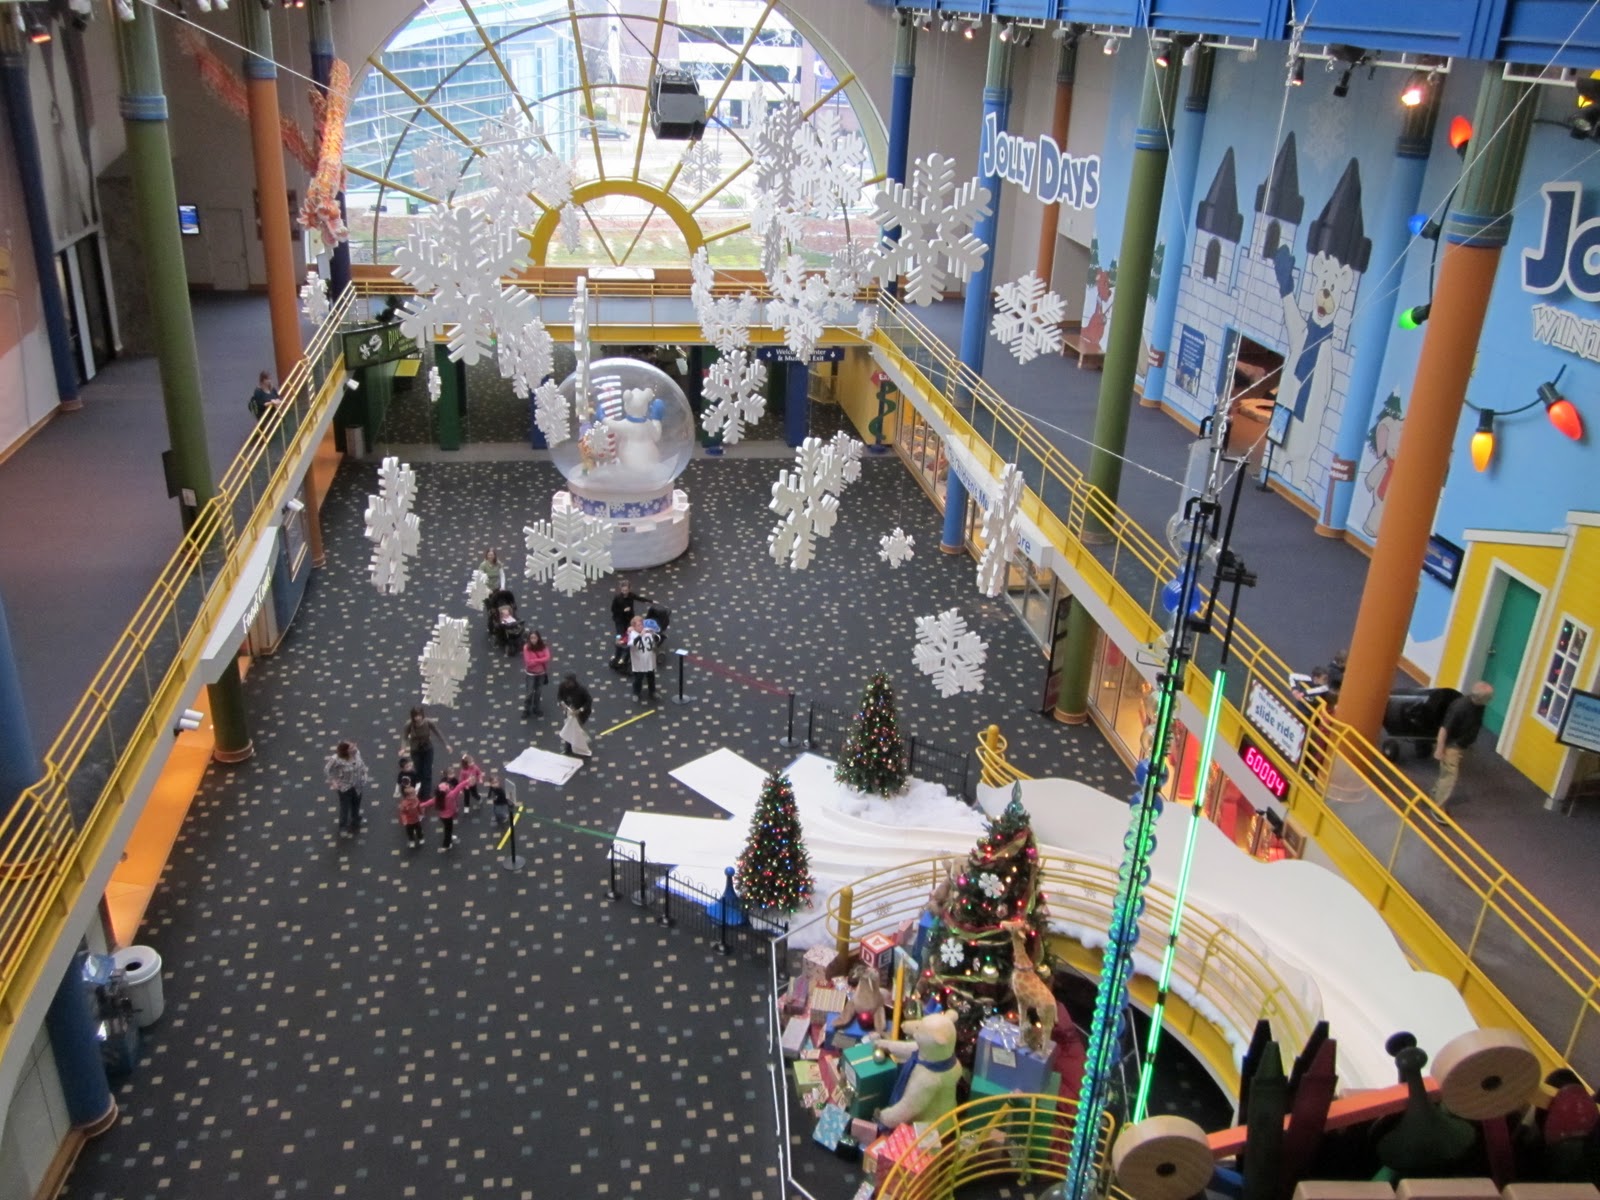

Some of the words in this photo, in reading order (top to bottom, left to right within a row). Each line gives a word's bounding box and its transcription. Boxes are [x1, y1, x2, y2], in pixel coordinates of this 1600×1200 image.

[984, 112, 1036, 193] JOLLY
[1037, 134, 1100, 210] DAYS
[633, 635, 653, 653] 43
[1255, 704, 1275, 727] slide
[1276, 721, 1296, 743] ride
[1245, 746, 1285, 797] 60004
